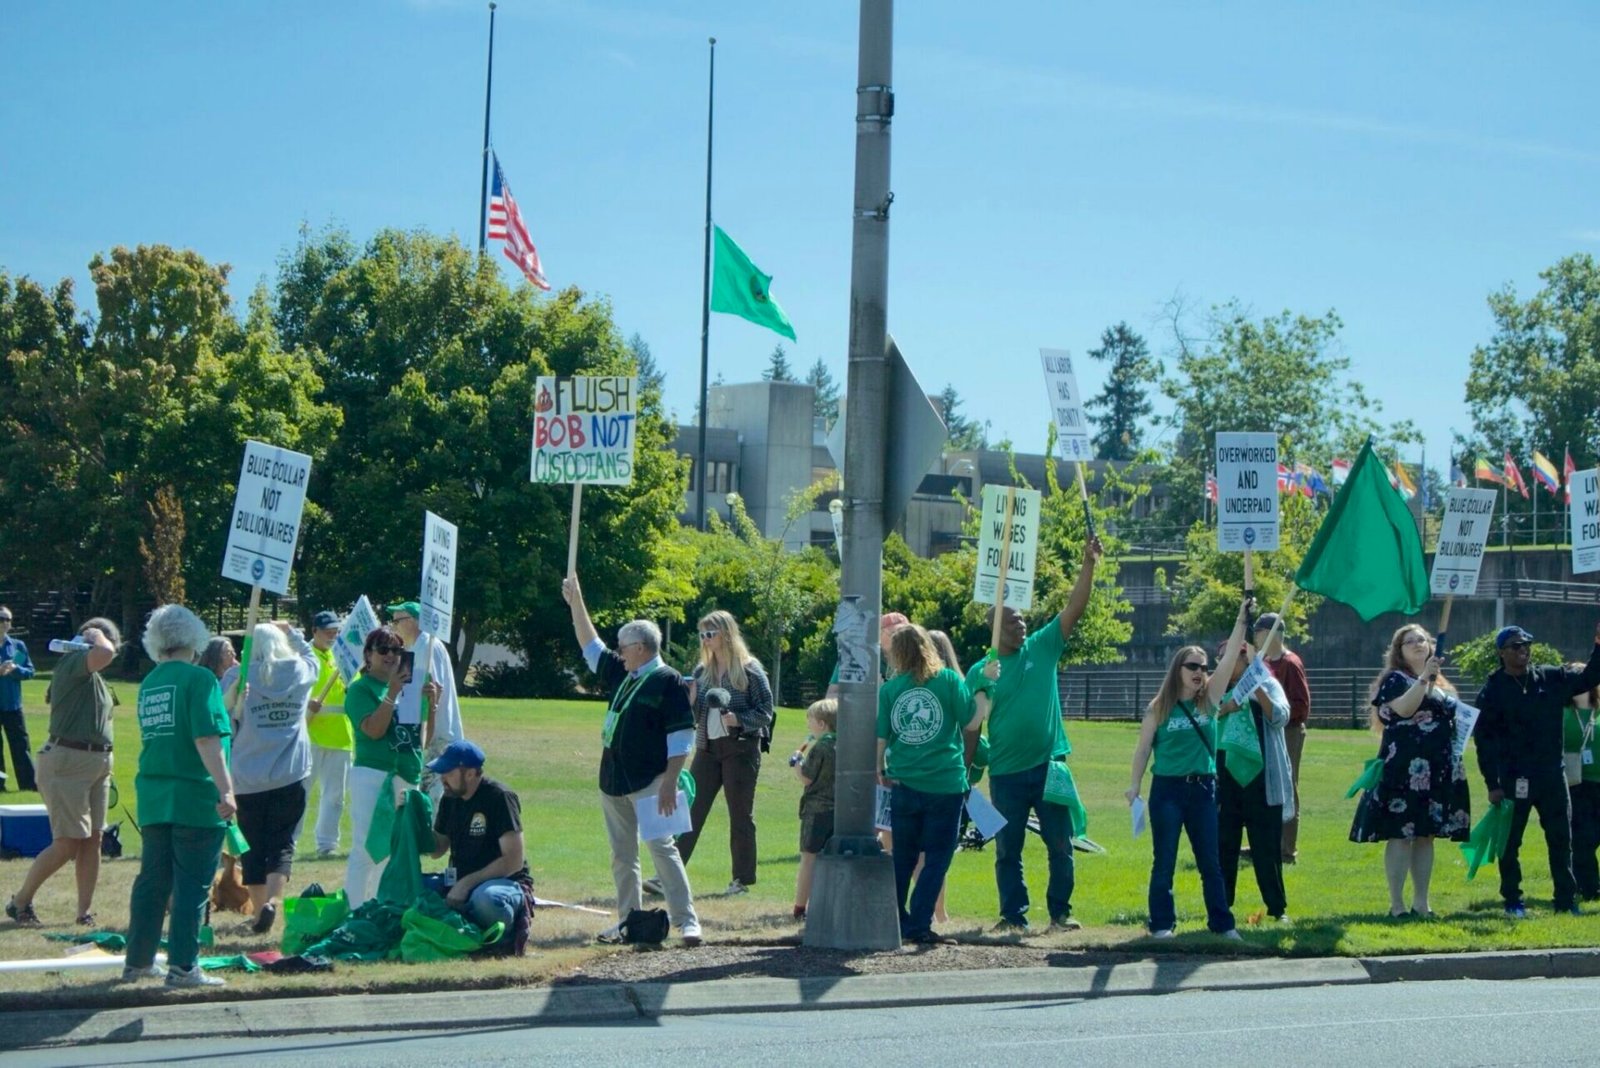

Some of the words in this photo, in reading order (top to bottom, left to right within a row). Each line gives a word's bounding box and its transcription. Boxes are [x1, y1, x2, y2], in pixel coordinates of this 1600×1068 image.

[1055, 357, 1073, 374] LABOR
[555, 377, 630, 415] FLUSH
[1057, 380, 1070, 400] HAS
[1057, 407, 1080, 427] DIGNITY
[535, 415, 586, 448] BOB
[592, 415, 635, 448] NOT
[1219, 447, 1276, 463] OVERWORKED
[246, 454, 271, 478] BLUE
[271, 461, 306, 488] COLLAR
[535, 448, 631, 483] CUSTODIANS
[1237, 470, 1259, 489] AND
[260, 487, 282, 512] NOT
[996, 494, 1027, 517] LING
[1225, 498, 1272, 514] UNDERPAID
[1449, 497, 1467, 513] BLUE
[1466, 499, 1492, 515] COLLAR
[236, 510, 295, 544] BILLIONAIRES
[1458, 520, 1474, 536] NOT
[1440, 541, 1483, 558] BILLIONAIRES
[431, 550, 450, 577] WAGES
[1008, 551, 1025, 572] ALL
[427, 576, 438, 599] FOR
[439, 583, 449, 604] ALL
[145, 692, 171, 705] PROUD
[251, 703, 270, 714] STATE
